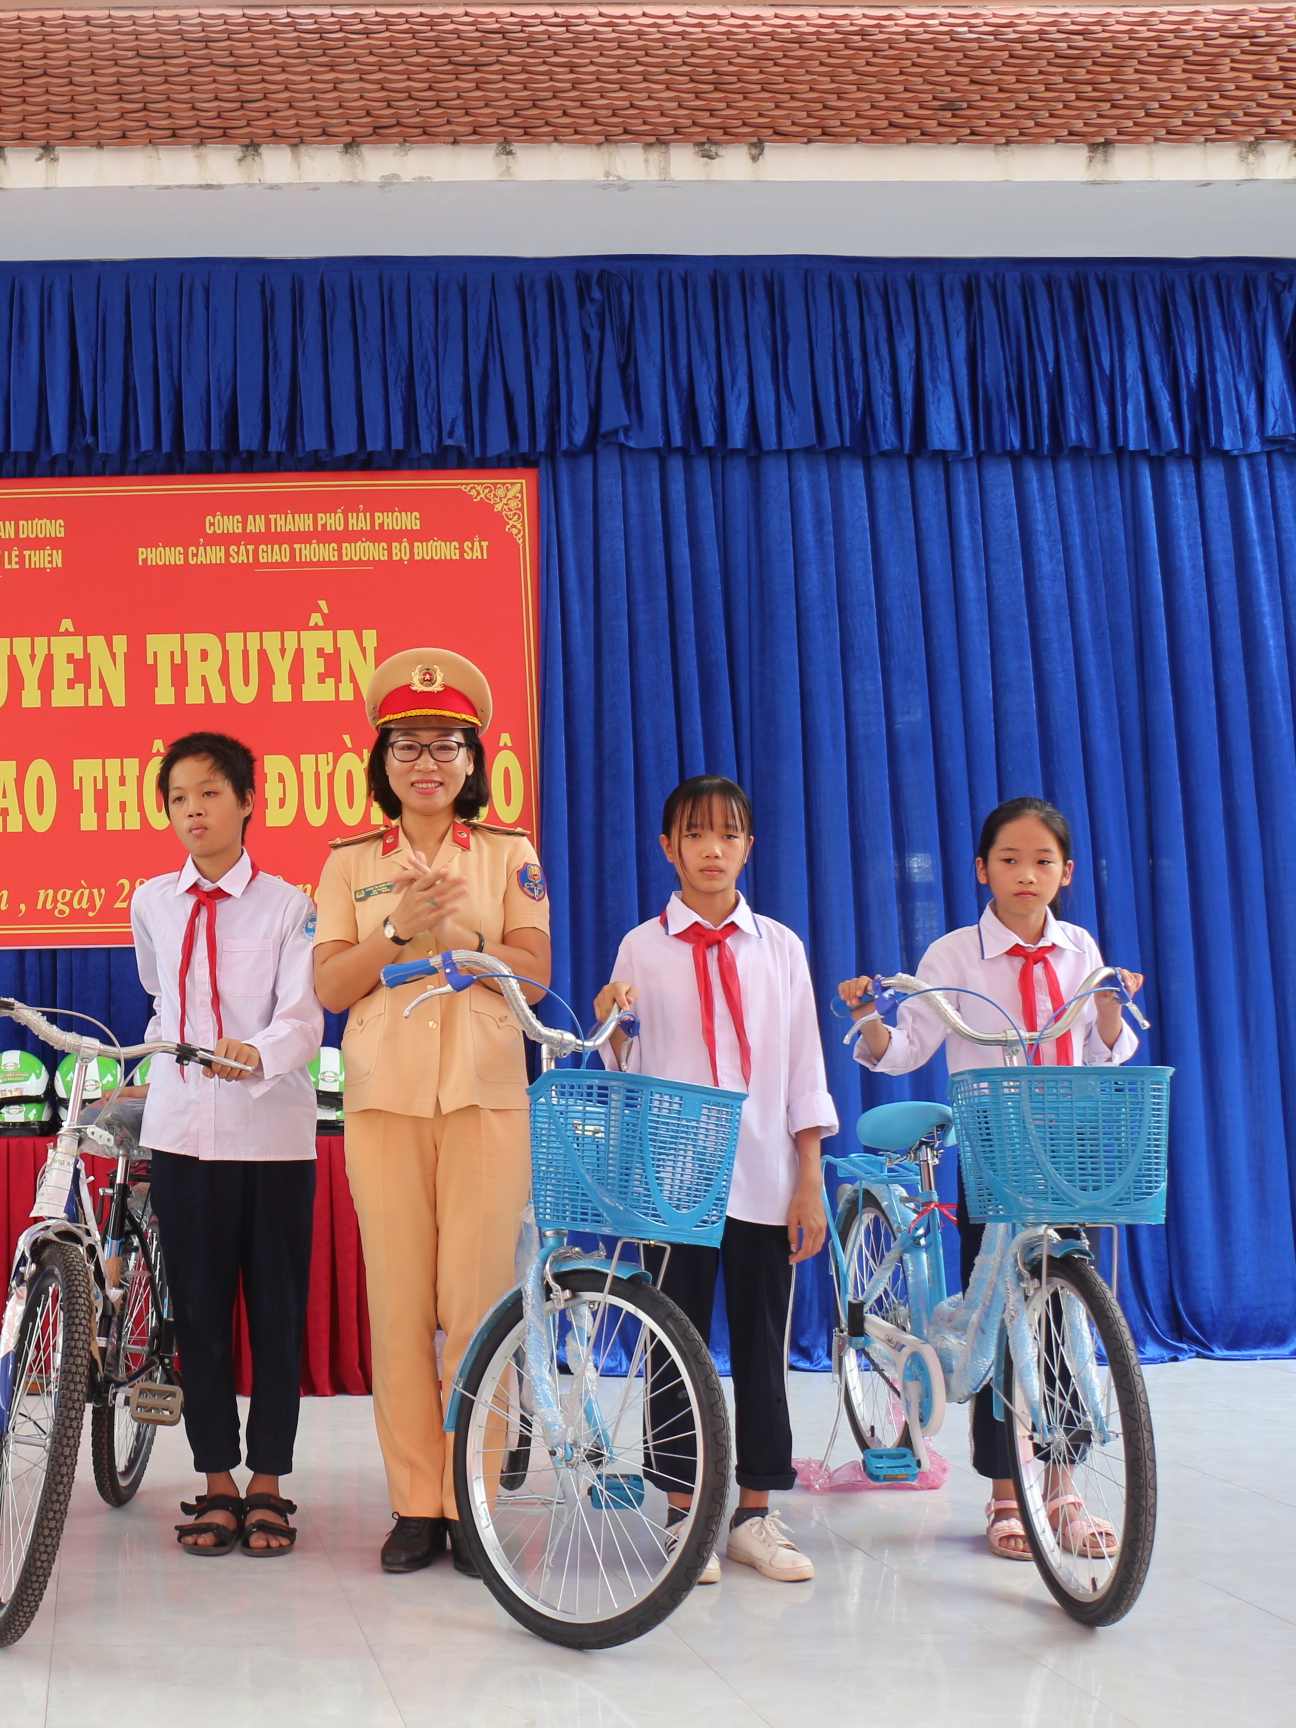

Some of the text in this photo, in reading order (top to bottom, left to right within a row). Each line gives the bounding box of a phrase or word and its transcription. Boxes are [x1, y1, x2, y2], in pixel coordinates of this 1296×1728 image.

[18, 518, 65, 539] DƯƠNG
[205, 504, 421, 534] CÔNG AN THÀNH PHỐ HẢI PHÒNG
[4, 546, 20, 569] LÊ
[22, 545, 63, 572] THIỆN
[137, 535, 489, 566] PHÒNG CẢNH SÁT GIAO THÔNG ĐƯỜNG BỘ ĐƯỜNG SẮT
[145, 599, 378, 706] TRUYỀN
[72, 738, 171, 832] THÔ
[36, 880, 106, 918] ngày
